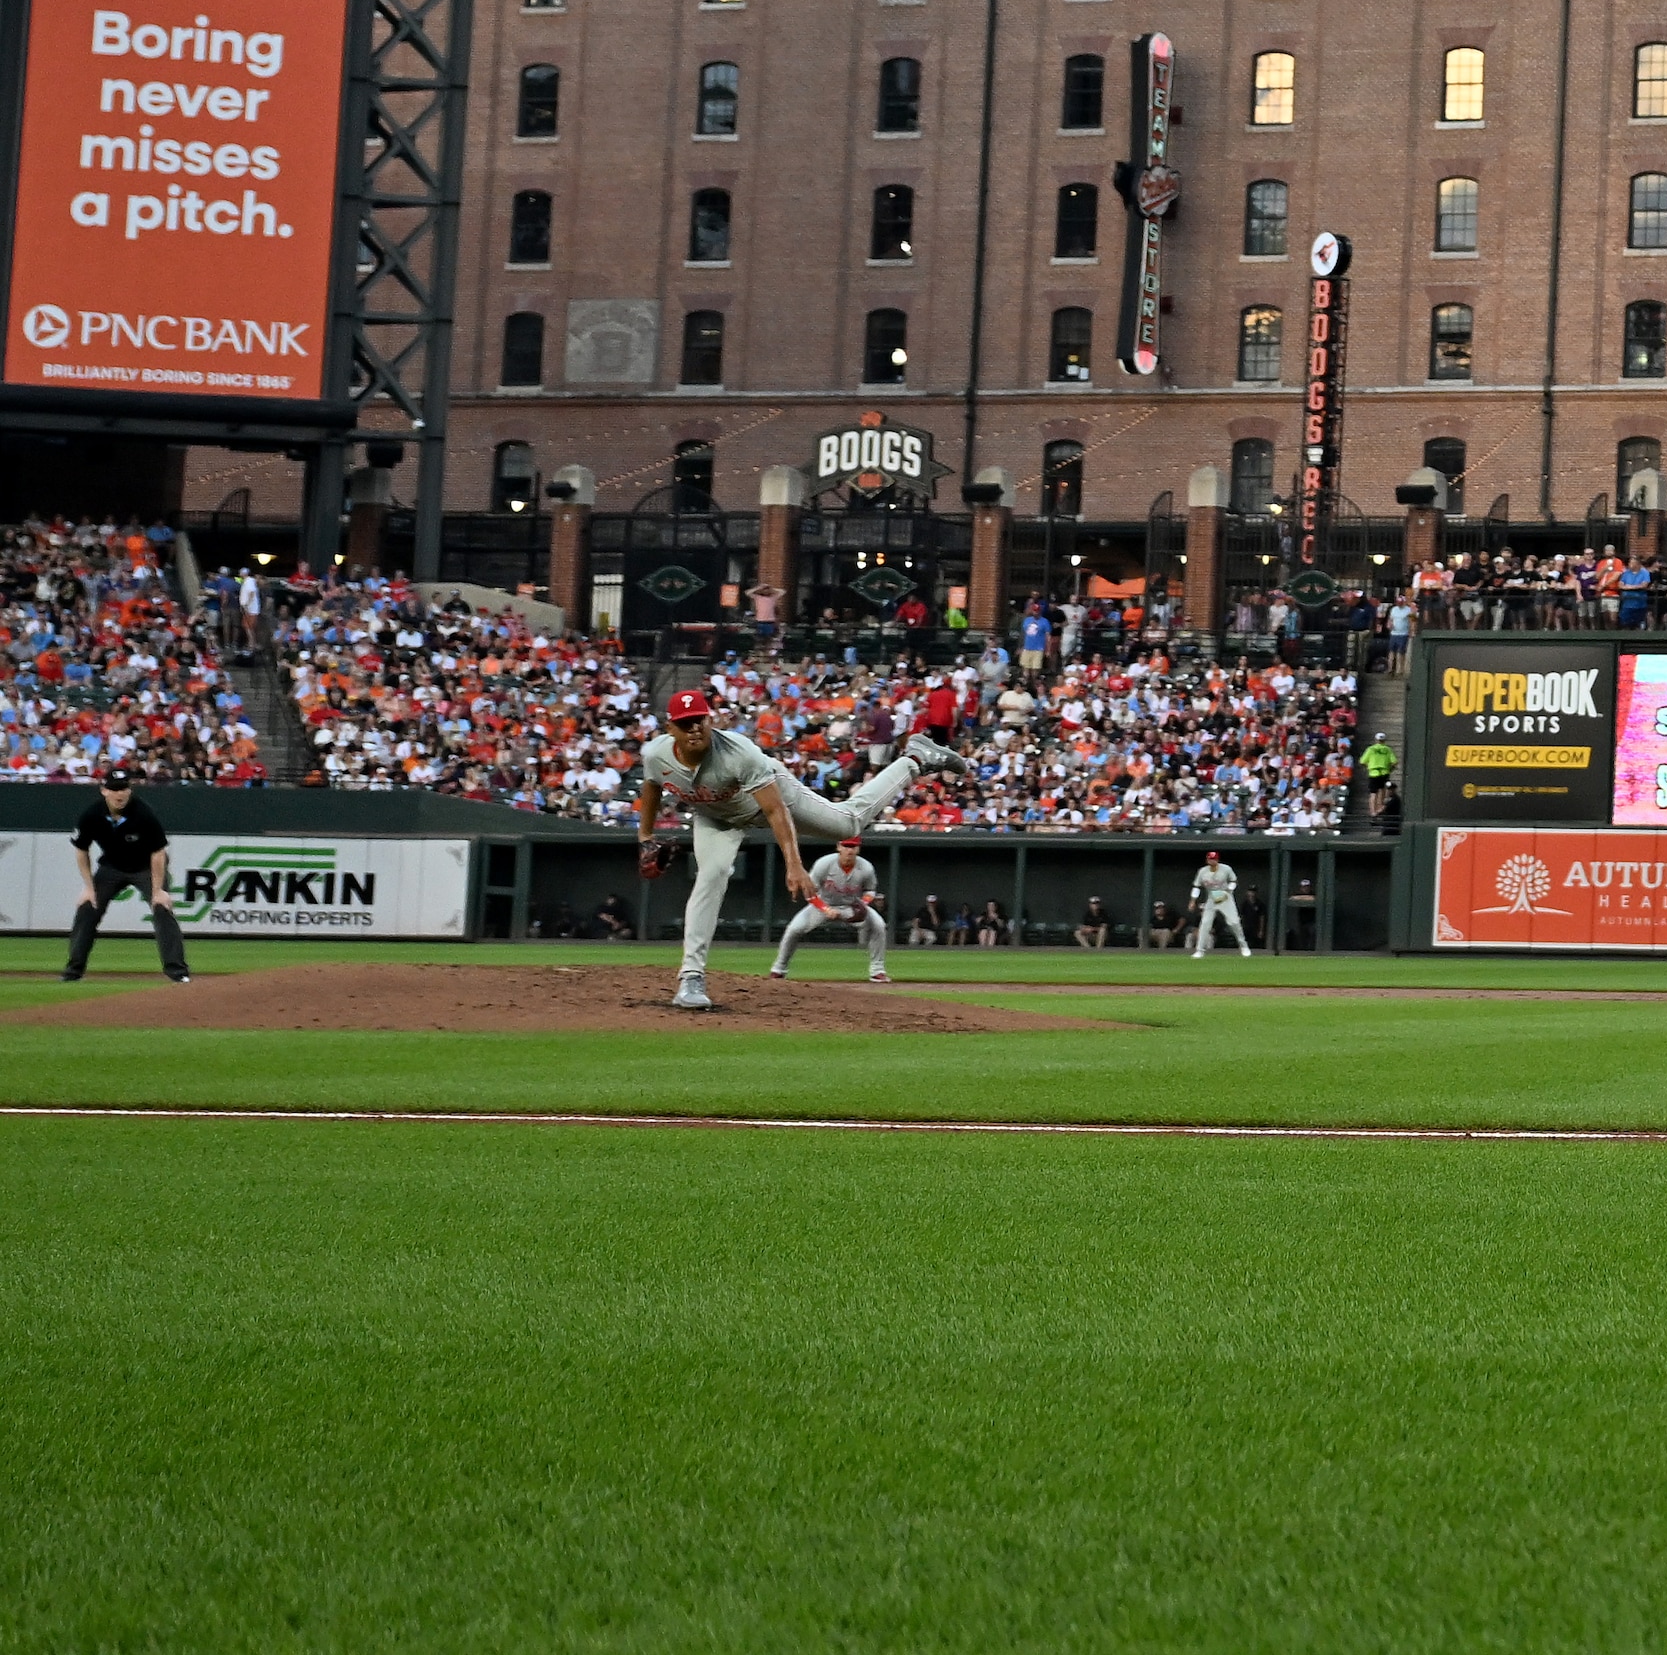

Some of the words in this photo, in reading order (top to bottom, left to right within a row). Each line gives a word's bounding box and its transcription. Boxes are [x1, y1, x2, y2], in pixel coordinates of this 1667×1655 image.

[91, 9, 284, 77] Boring
[100, 77, 270, 122] never
[1153, 62, 1168, 157] TEAM
[79, 124, 281, 180] misses
[70, 190, 109, 227] a
[124, 183, 295, 239] pitch.
[1142, 222, 1160, 344] STORE
[77, 310, 178, 350] PNC
[180, 316, 310, 357] BANK
[42, 363, 140, 382] BRILLIANTLY
[141, 368, 205, 385] BORING
[207, 372, 254, 387] SINCE
[819, 430, 922, 478] BOOG'S
[1442, 667, 1599, 717] SUPERBOOK
[1474, 715, 1561, 733] SPORTS
[1452, 749, 1584, 763] SUPERBOOK.COM
[185, 869, 375, 905] RANKIN
[210, 909, 290, 925] ROOFING
[295, 910, 374, 926] EXPERTS
